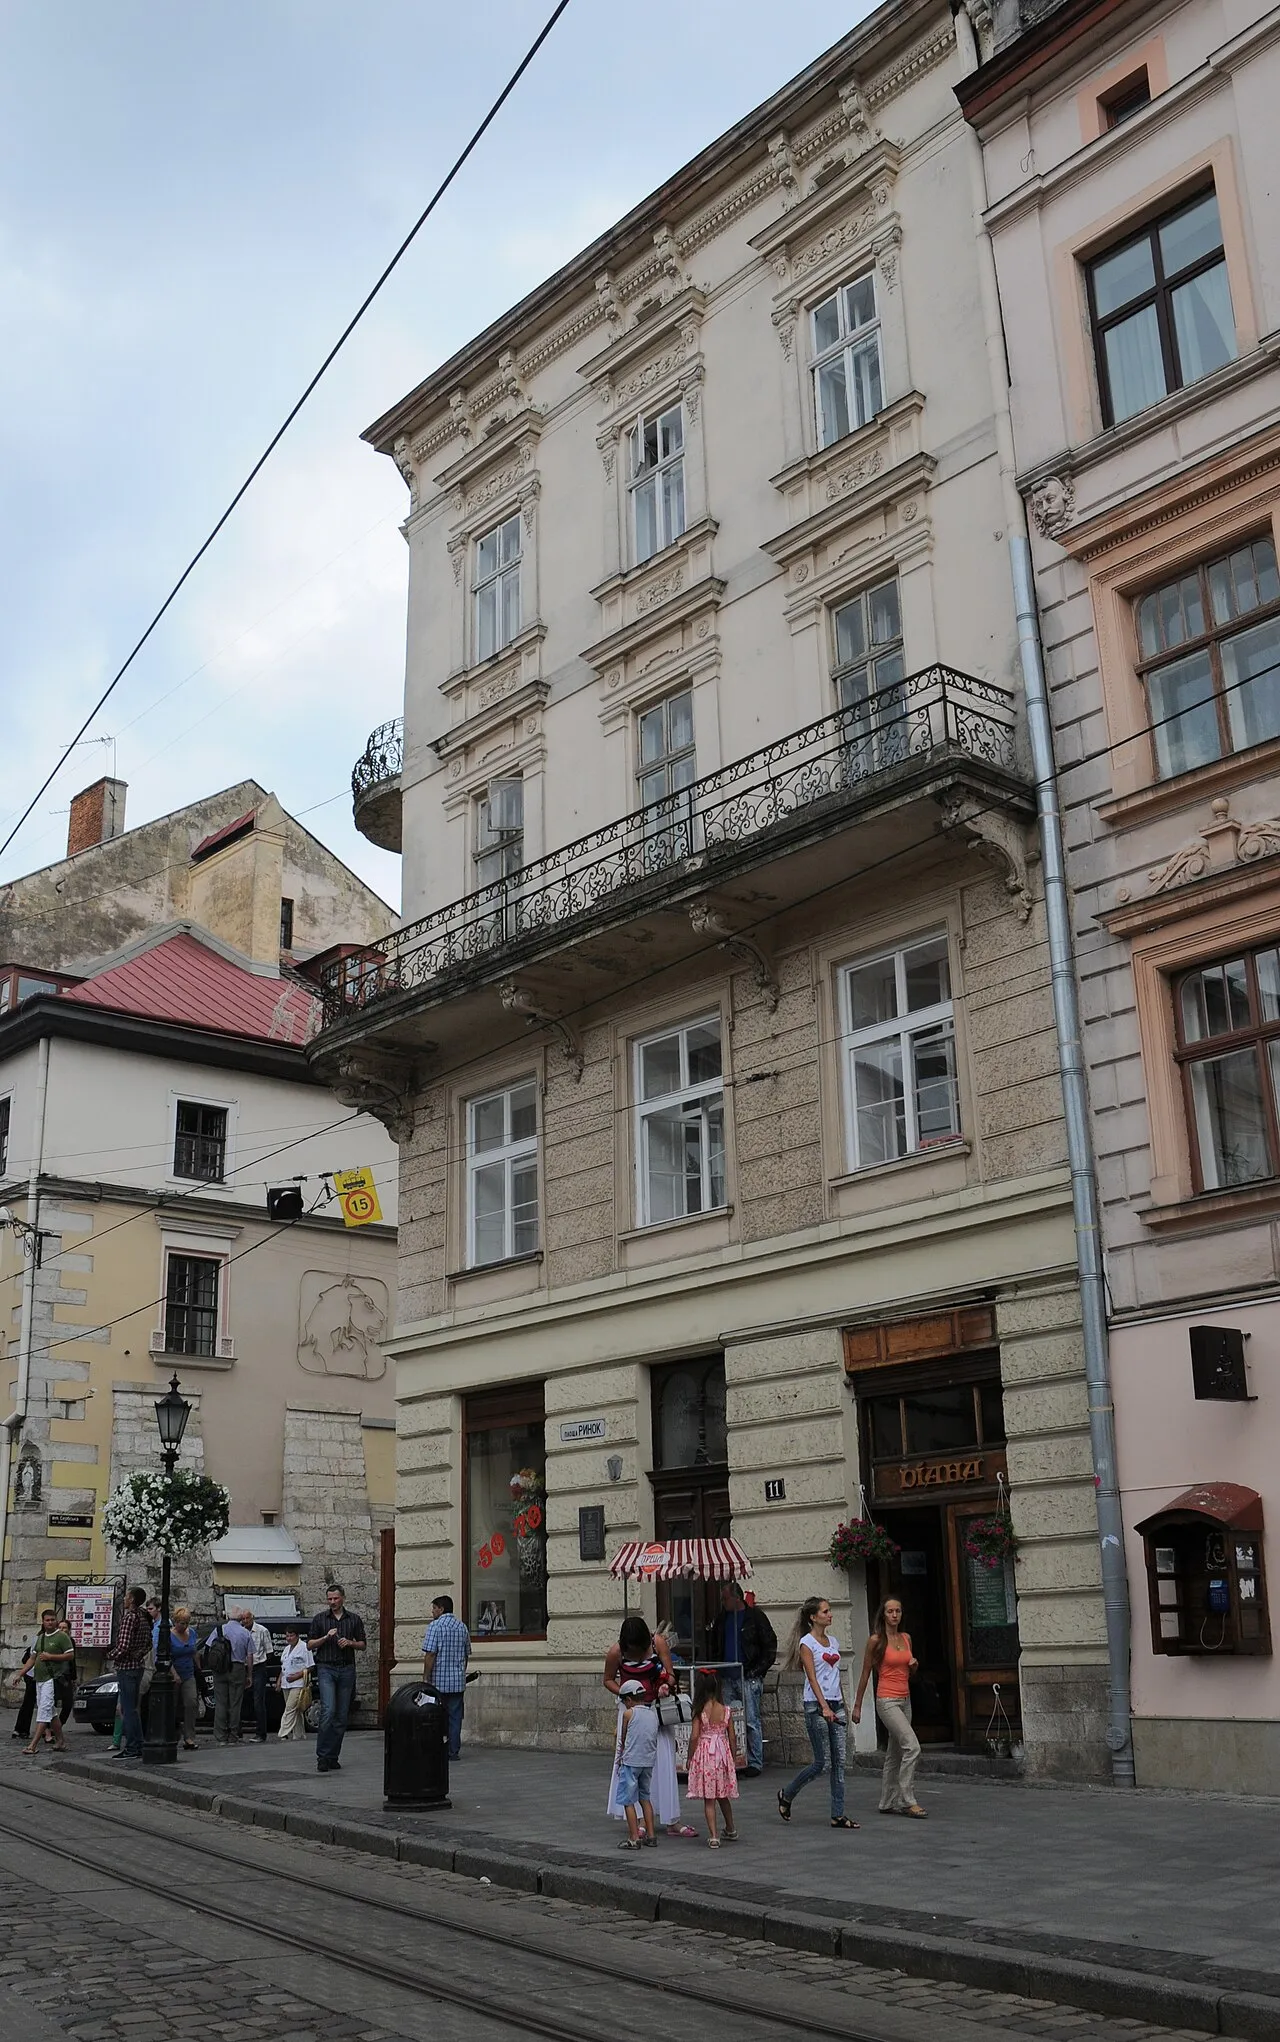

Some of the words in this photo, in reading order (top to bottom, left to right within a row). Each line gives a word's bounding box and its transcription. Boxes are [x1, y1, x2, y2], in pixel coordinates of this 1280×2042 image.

[352, 1198, 368, 1212] 15
[578, 1423, 601, 1436] РИНОК
[768, 1481, 780, 1497] 11
